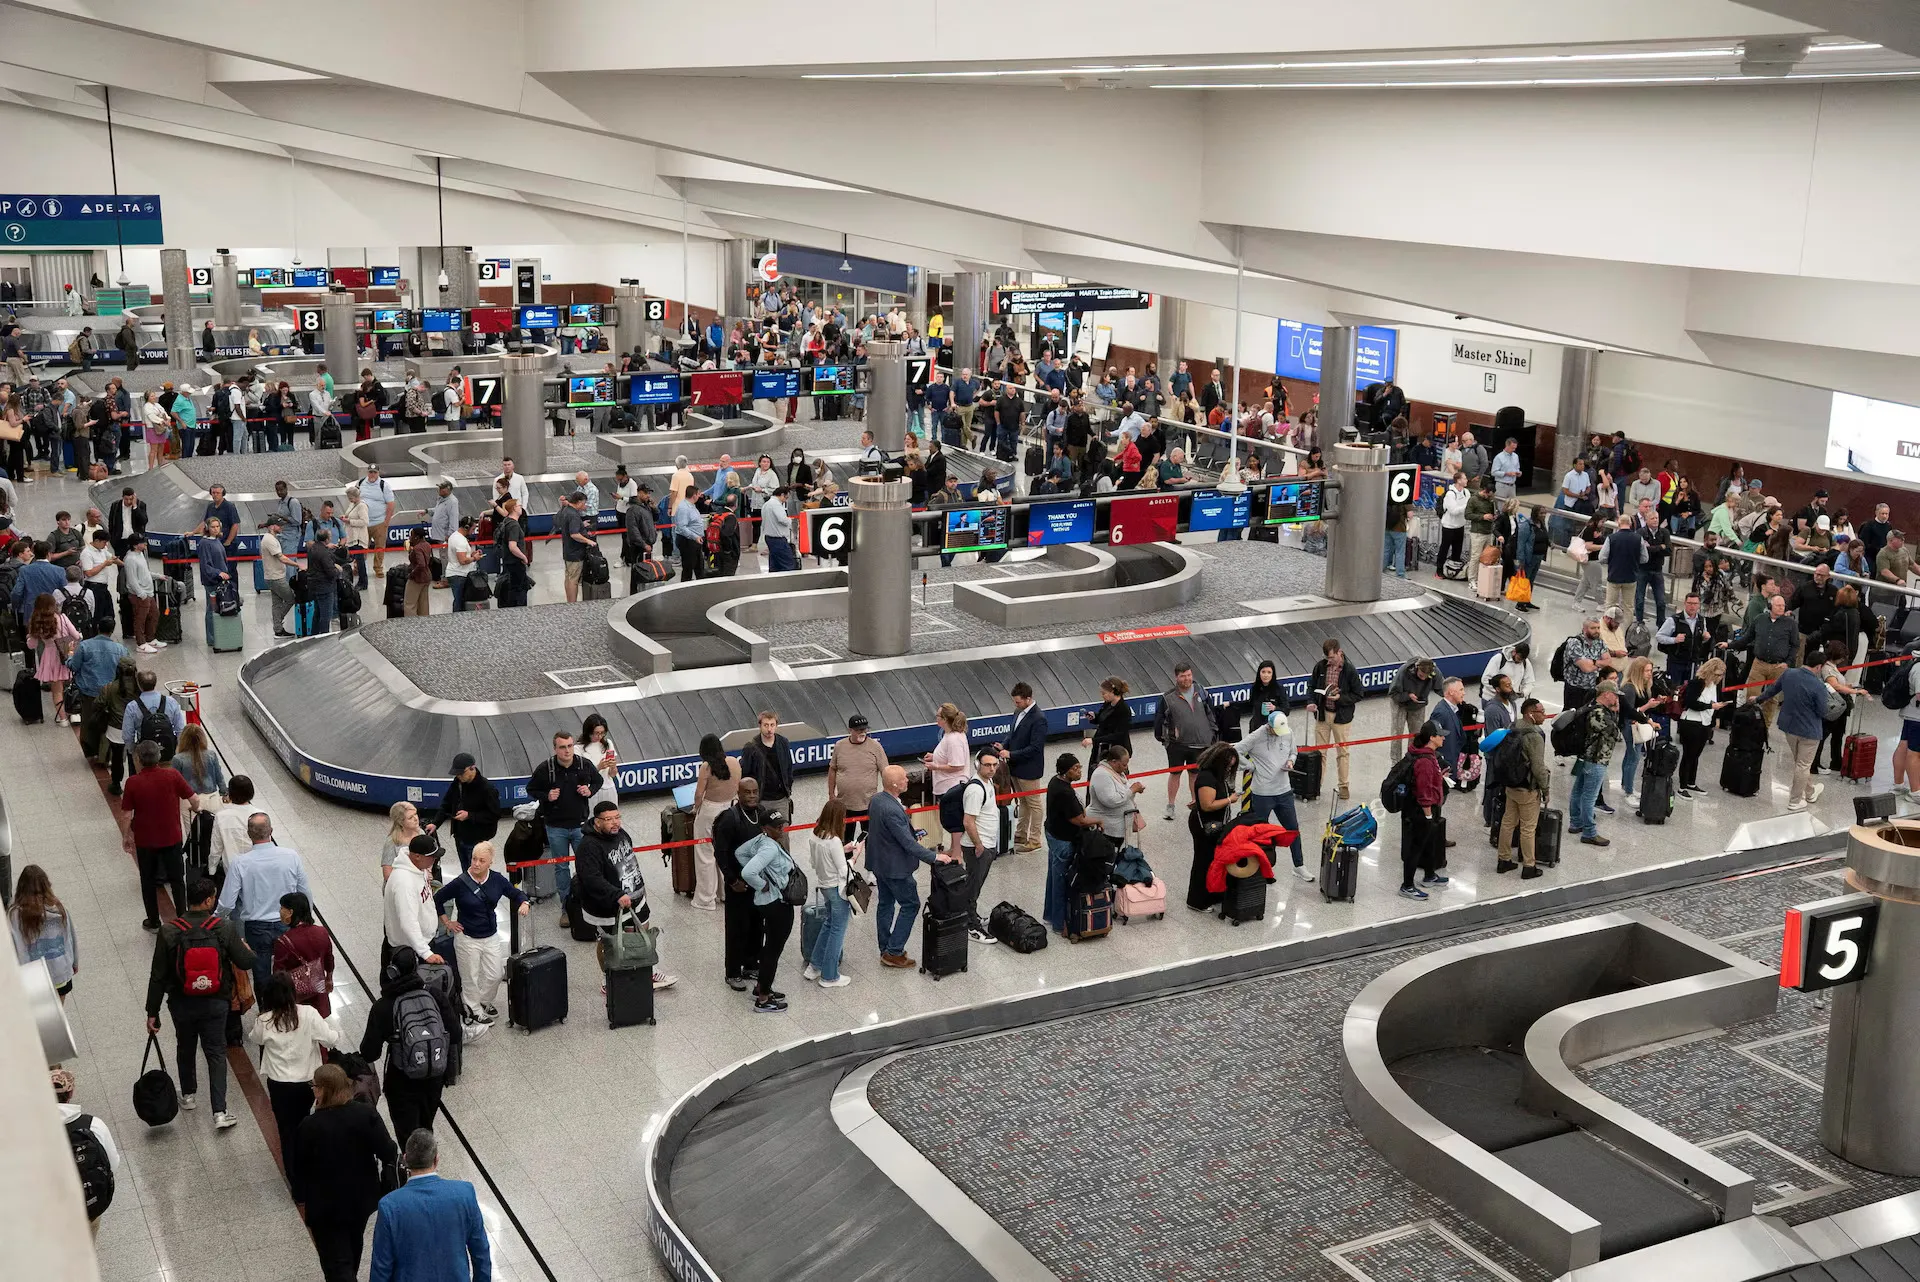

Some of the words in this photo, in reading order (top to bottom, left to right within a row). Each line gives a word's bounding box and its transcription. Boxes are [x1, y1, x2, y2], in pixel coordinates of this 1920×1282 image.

[95, 203, 140, 213] DETA
[195, 269, 209, 285] 9
[481, 264, 494, 279] 9
[647, 301, 662, 320] 8
[303, 311, 320, 331] 8
[472, 321, 481, 333] 8
[1454, 343, 1492, 362] Master
[1495, 349, 1527, 368] Shine
[911, 361, 927, 384] 7
[478, 379, 497, 405] 7
[693, 391, 702, 404] 7
[1390, 472, 1411, 503] 6
[1066, 512, 1078, 520] YOU
[819, 516, 846, 551] 6
[1111, 524, 1124, 544] 6
[807, 743, 836, 762] FLIE
[314, 771, 368, 795] DELTA.COM/AMEX
[616, 767, 659, 789] YOUR
[661, 763, 701, 783] FIRST
[1818, 915, 1864, 981] 5
[656, 1221, 685, 1280] YOUR
